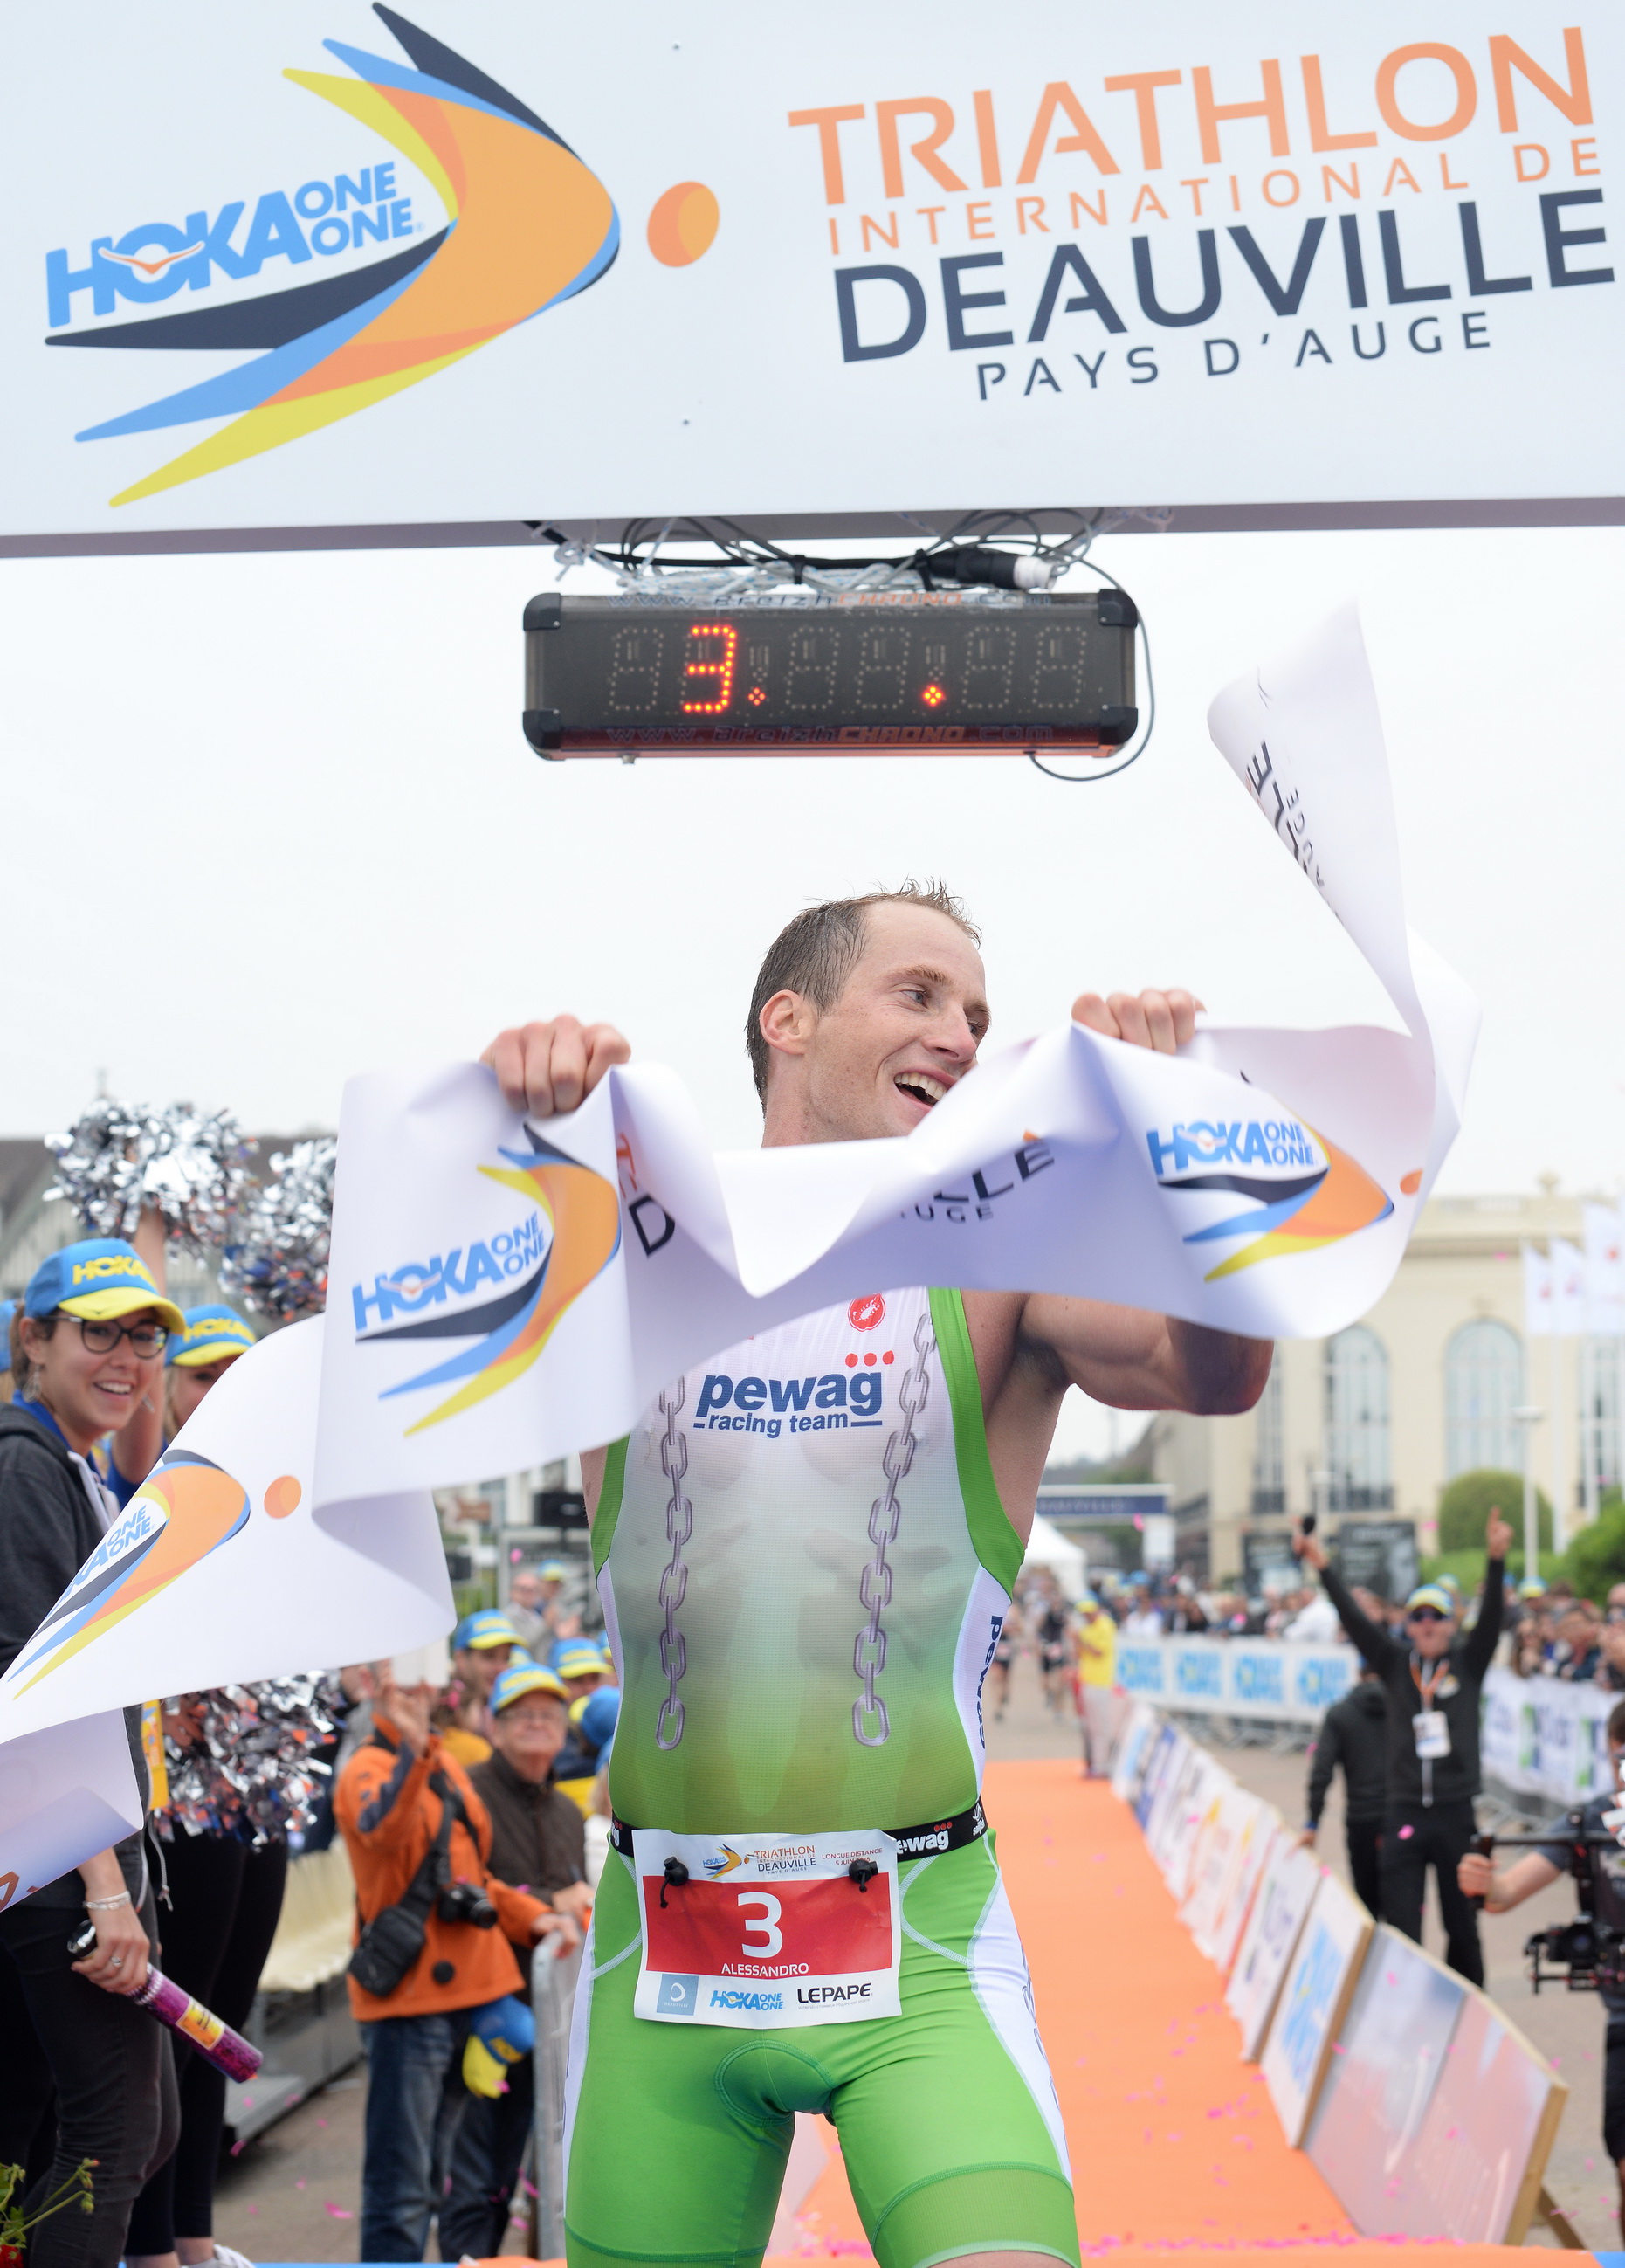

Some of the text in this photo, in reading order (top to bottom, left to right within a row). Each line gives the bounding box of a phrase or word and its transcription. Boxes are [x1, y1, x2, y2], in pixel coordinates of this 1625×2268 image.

[788, 26, 1594, 205] TRIATHLON
[294, 162, 396, 219] ONE
[827, 137, 1601, 256] INTERNATIONAL DE
[310, 198, 413, 257] ONE
[46, 190, 312, 327] HOKA
[833, 187, 1616, 363] DEAUVILLE
[976, 311, 1492, 401] PAYS D'AUGE
[1146, 1122, 1272, 1175] HOKA
[491, 1211, 538, 1255] ONE
[503, 1230, 546, 1275] ONE
[72, 1255, 157, 1290] HOKA
[352, 1240, 505, 1331] HOKA
[696, 1372, 882, 1417] pewag
[708, 1413, 848, 1438] racing team
[107, 1505, 147, 1546] ONE
[109, 1516, 151, 1557] ONE
[754, 1845, 815, 1858] TRIATHLON
[758, 1858, 816, 1872] DEAUVILLE
[850, 1848, 883, 1857] DISTANCE
[737, 1891, 784, 1959] 3
[721, 1963, 809, 1977] ALESSANDRO
[710, 1990, 761, 2010] HOKA
[760, 1993, 782, 2002] ONE
[761, 2001, 784, 2010] ONE
[797, 1982, 871, 2003] LEPAPE
